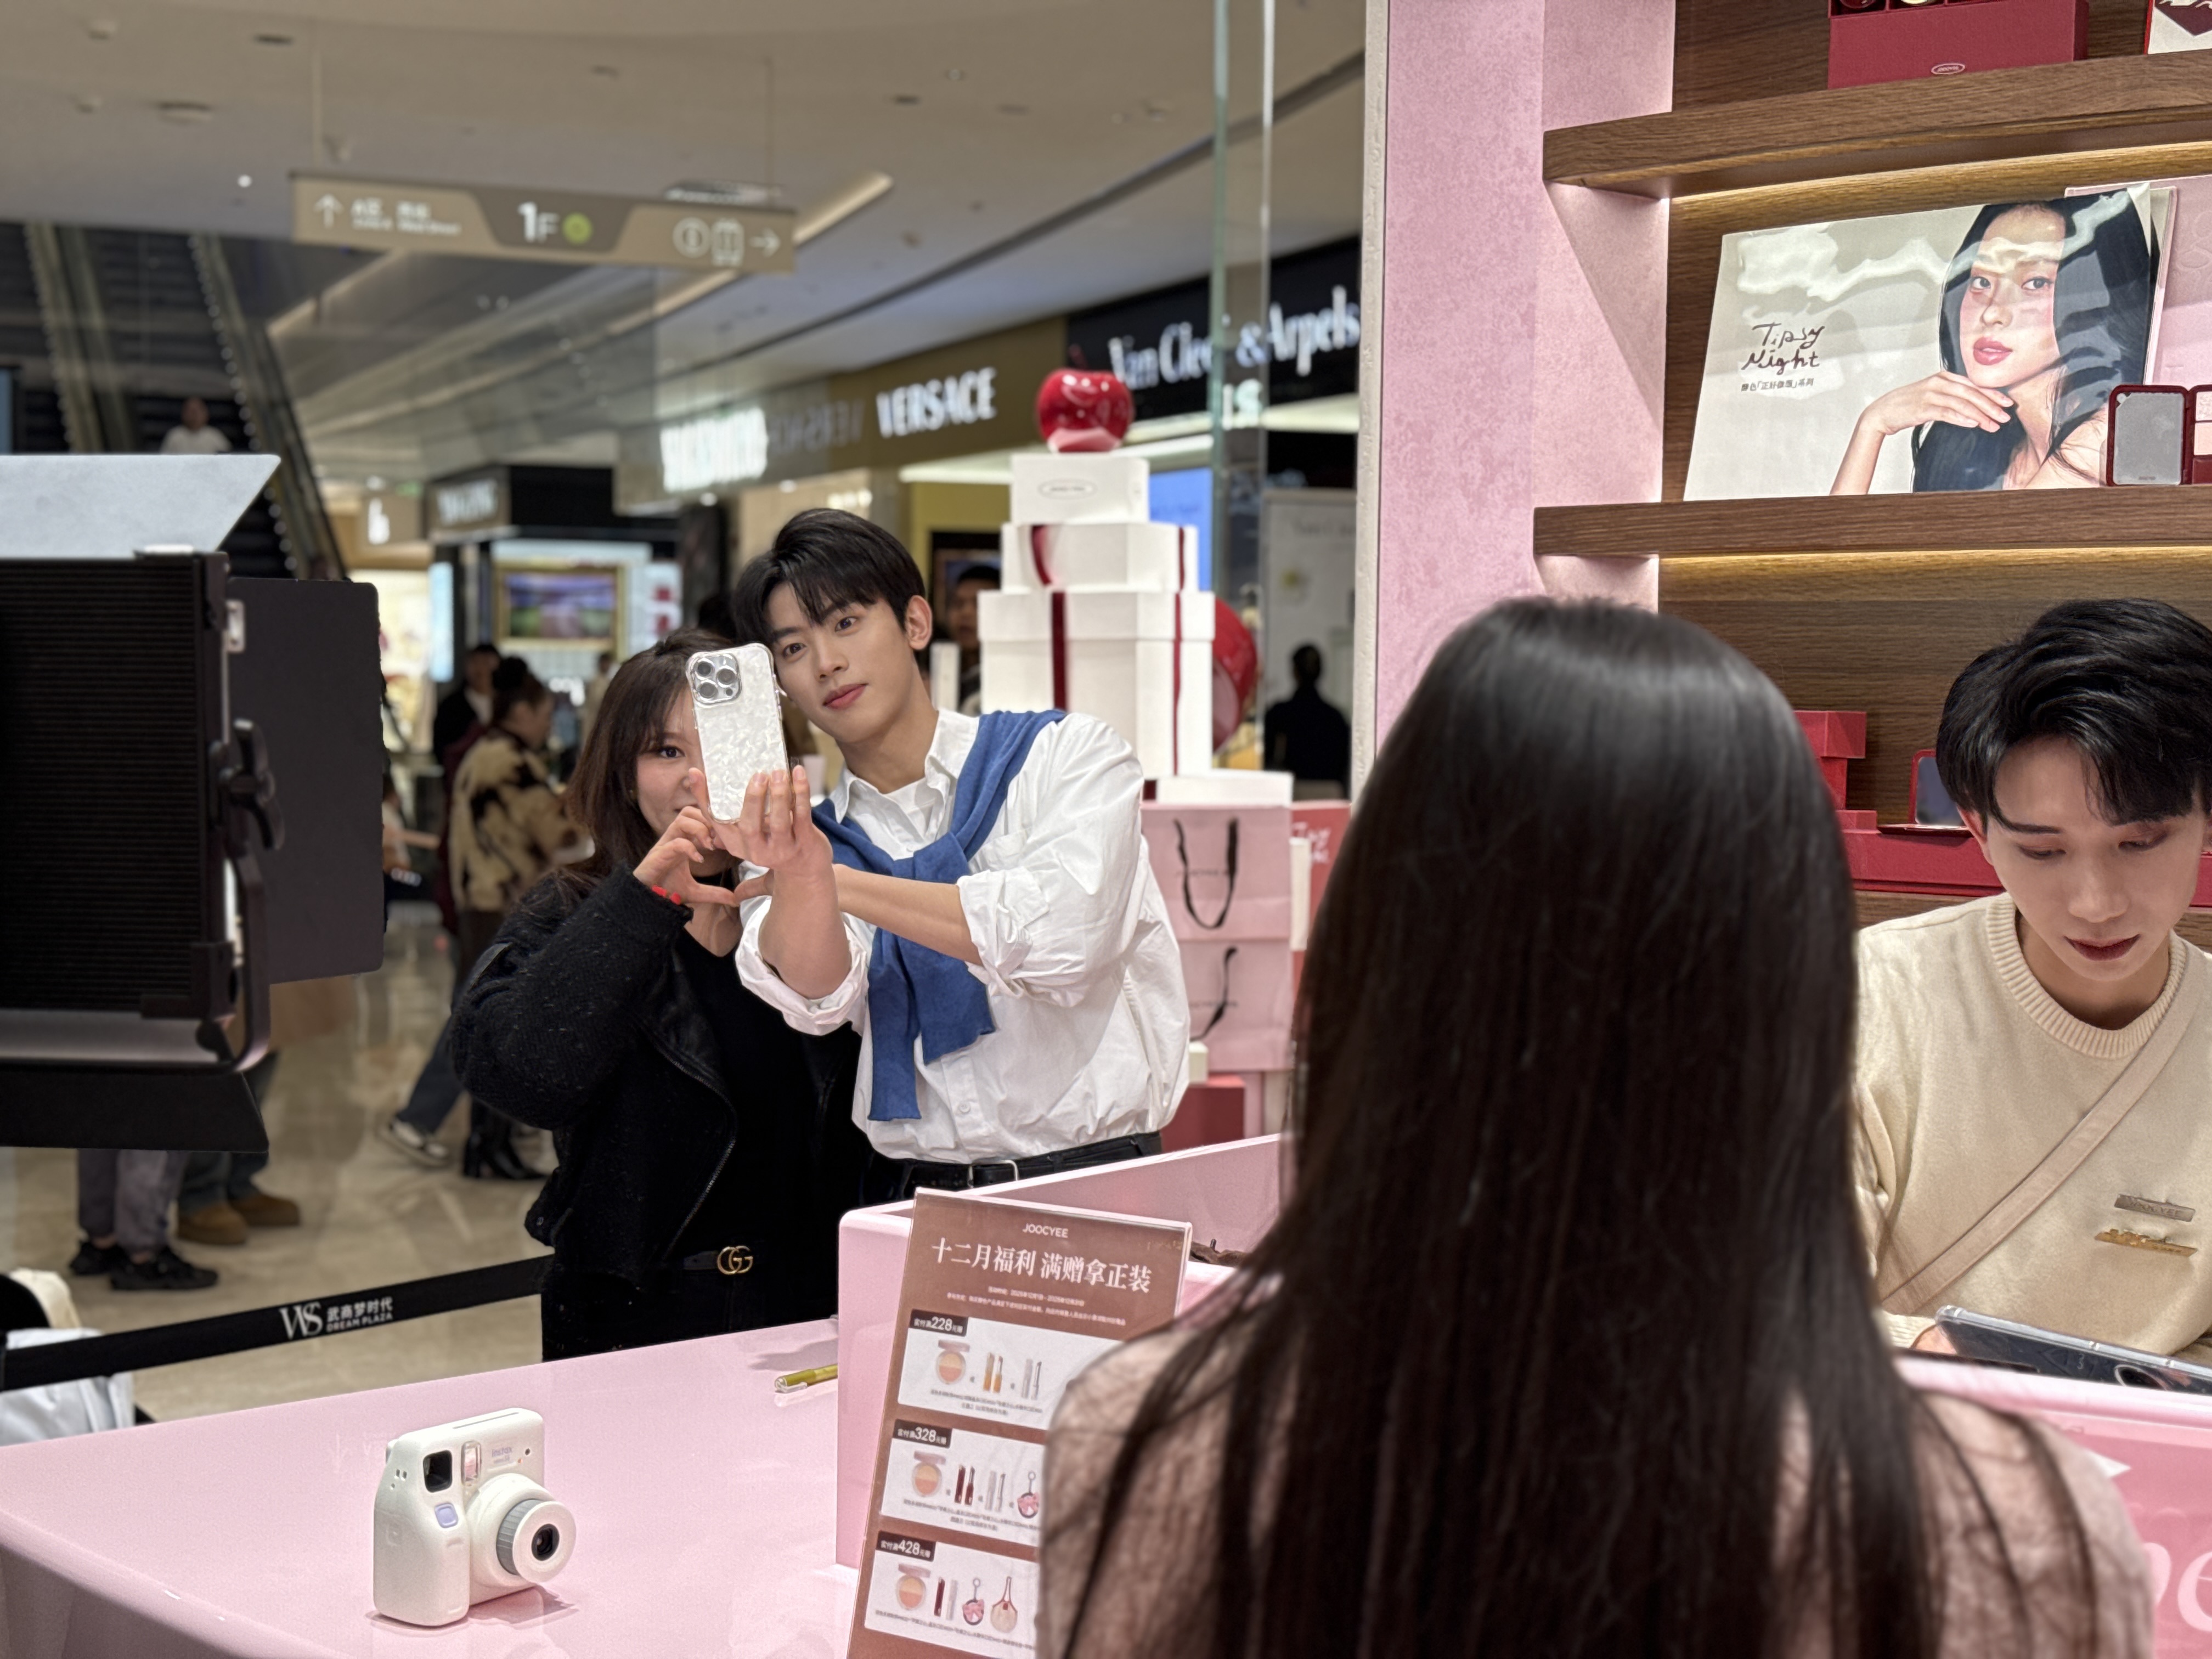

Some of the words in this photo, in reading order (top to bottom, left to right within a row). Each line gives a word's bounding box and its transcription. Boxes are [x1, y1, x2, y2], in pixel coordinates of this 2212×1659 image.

[518, 201, 560, 242] 1F
[1235, 321, 1268, 367] &
[1264, 285, 1360, 376] Arpels
[1752, 321, 1825, 349] Tipsy
[1741, 349, 1820, 375] Night
[877, 366, 997, 438] VERSACE
[1022, 1223, 1068, 1238] JOOCYEE
[932, 1237, 1036, 1276] 十二月福利
[1041, 1252, 1152, 1293] 满赠拿正装
[326, 1318, 360, 1332] DREAM
[362, 1312, 393, 1325] PLAZA
[327, 1296, 392, 1322] 武商梦时代
